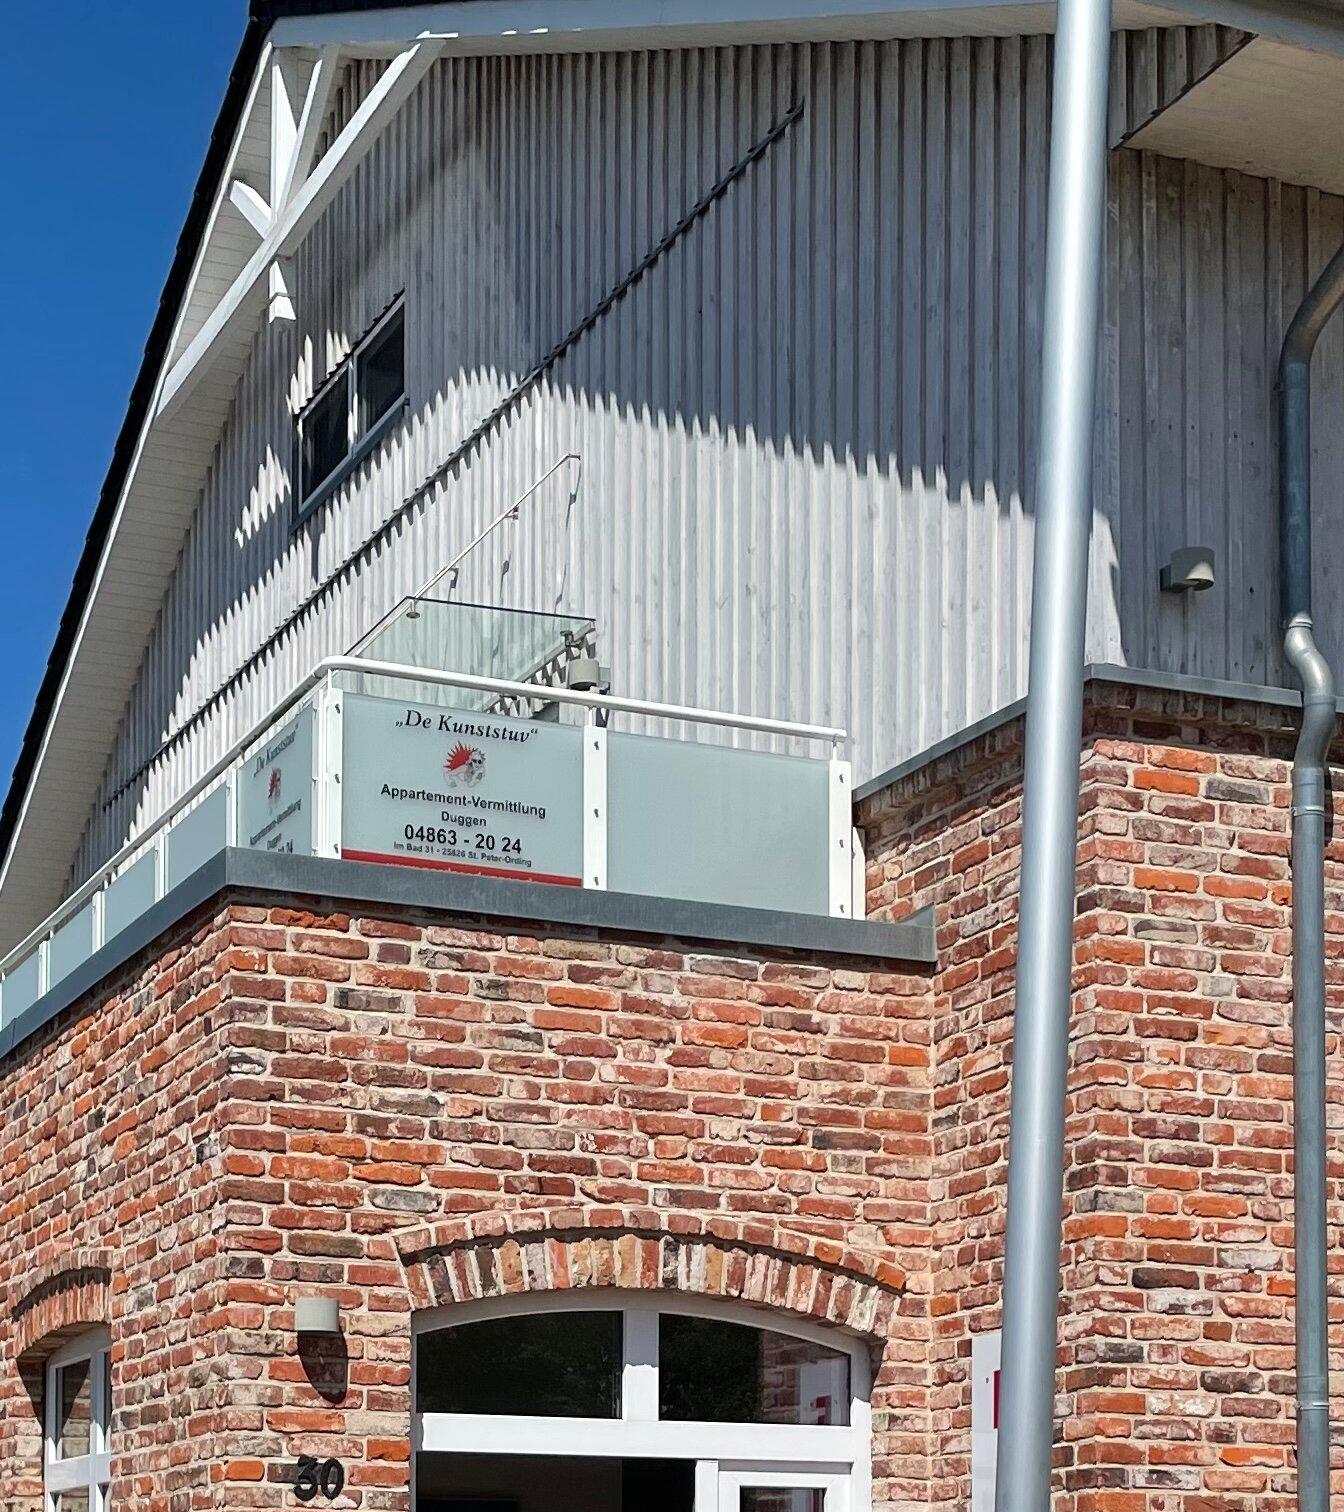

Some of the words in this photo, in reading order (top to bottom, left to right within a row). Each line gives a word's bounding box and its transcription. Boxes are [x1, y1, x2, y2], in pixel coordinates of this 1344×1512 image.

[395, 709, 432, 729] „De
[438, 714, 538, 743] Kunststuv“
[381, 784, 546, 819] Appartement-Vermittlung
[441, 811, 487, 827] Duggen
[405, 824, 457, 846] 04863
[475, 833, 495, 850] 20
[501, 837, 522, 854] 24
[407, 843, 423, 853] Bad
[293, 1455, 344, 1500] 30
